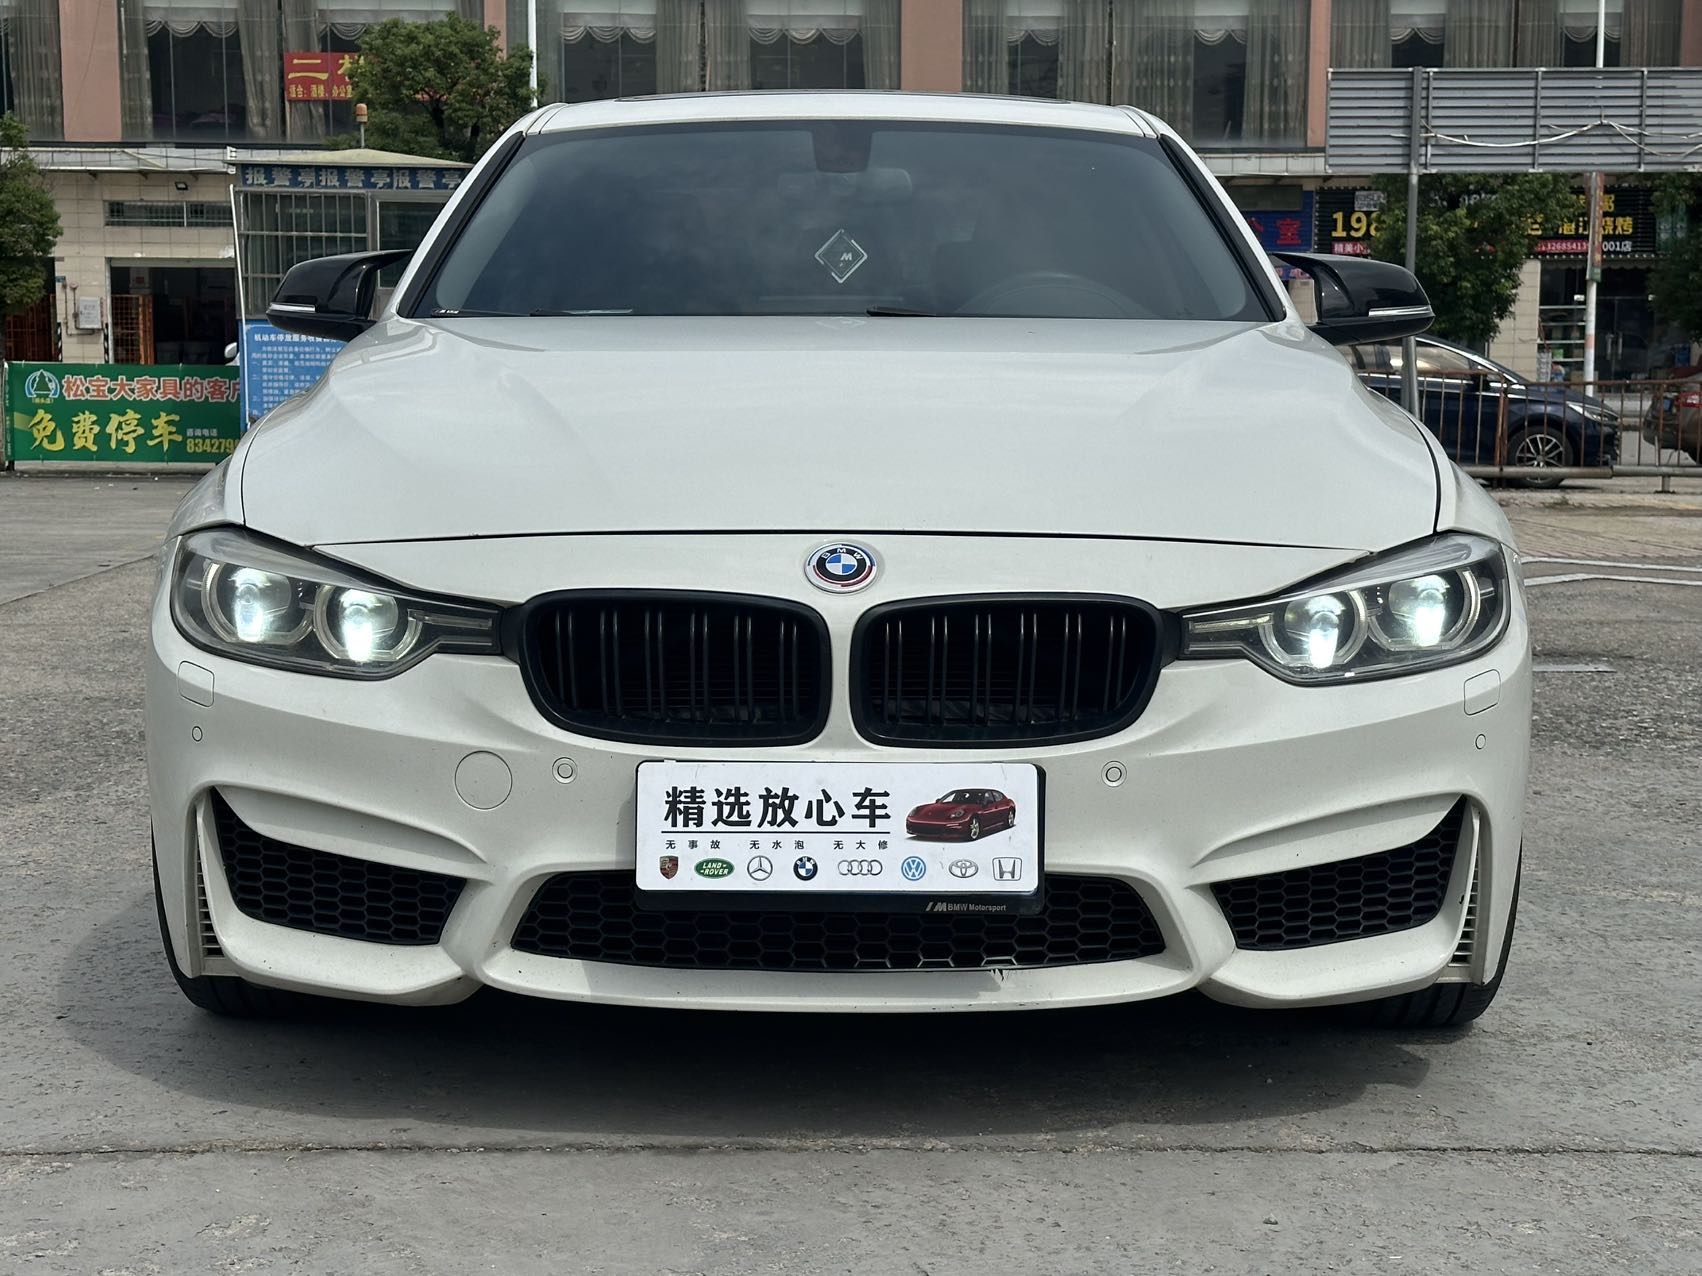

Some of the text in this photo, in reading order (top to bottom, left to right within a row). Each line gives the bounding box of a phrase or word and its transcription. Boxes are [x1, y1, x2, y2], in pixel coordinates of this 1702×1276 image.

[28, 409, 183, 454] 免费停车
[821, 548, 864, 560] BMW
[663, 786, 891, 829] 精选放心车
[665, 839, 889, 850] 无事故 无水泡 无大修
[947, 903, 968, 911] BMW
[968, 903, 1006, 912] Motorsport
